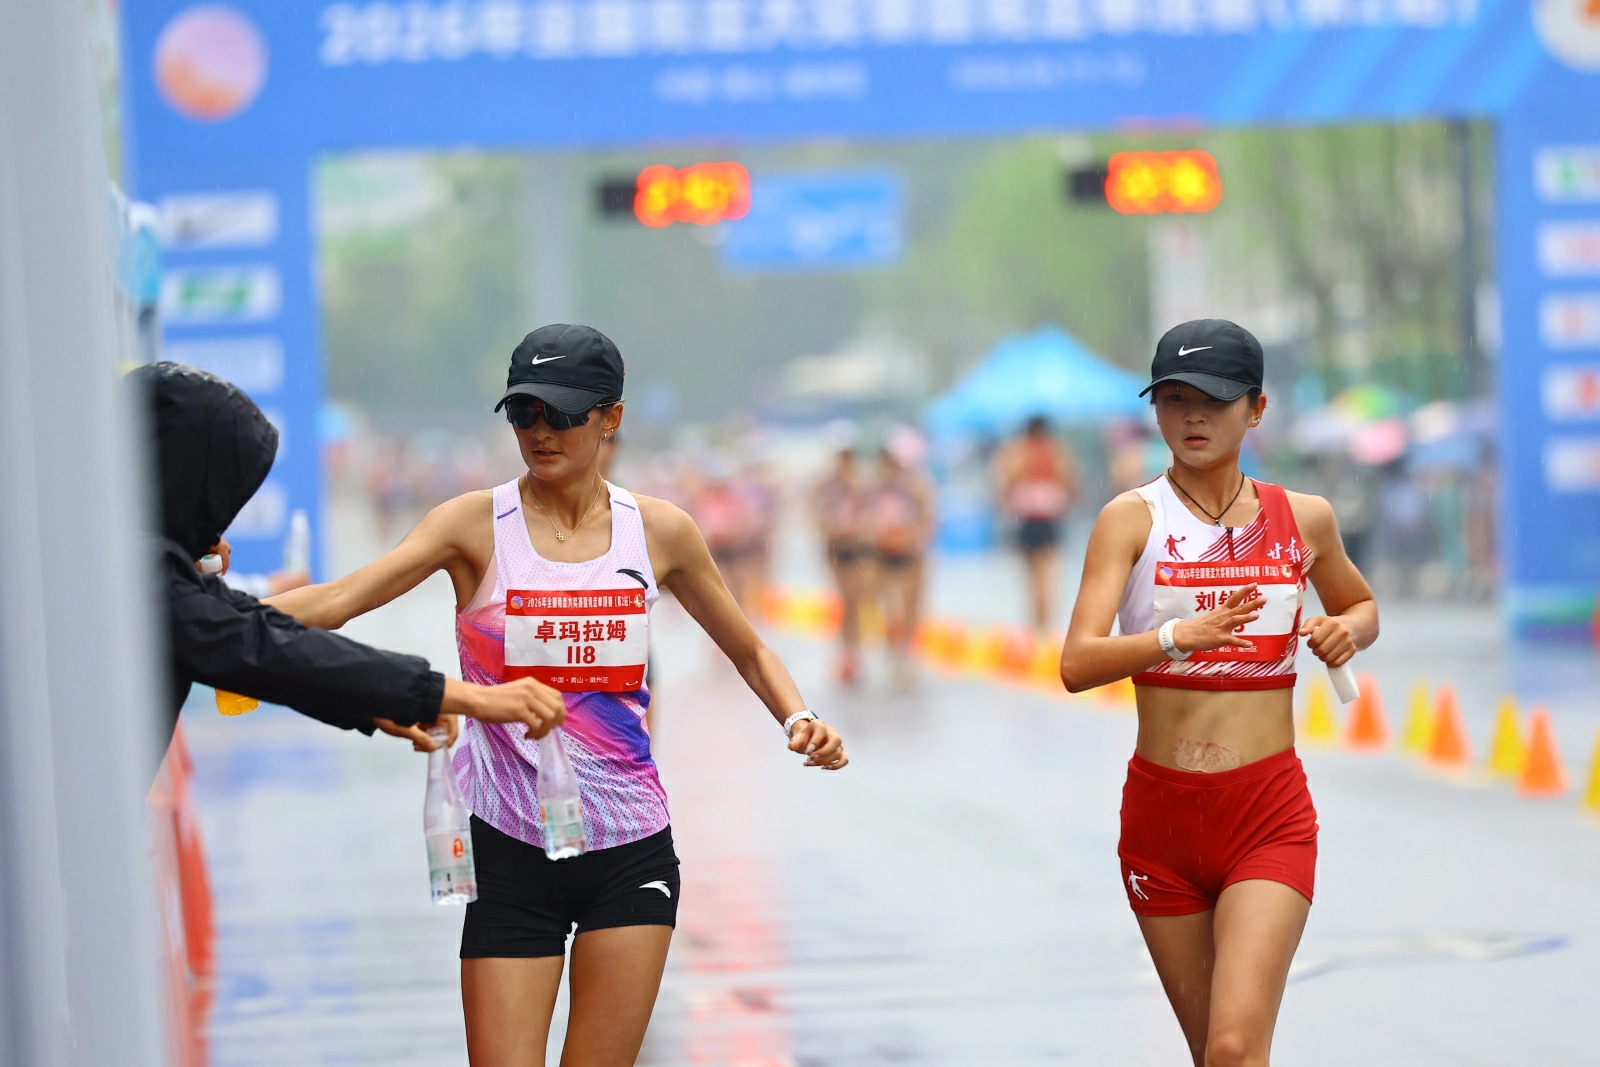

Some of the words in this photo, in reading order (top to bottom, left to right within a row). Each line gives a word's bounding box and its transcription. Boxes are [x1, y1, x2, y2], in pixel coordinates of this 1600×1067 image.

[534, 619, 627, 643] 卓玛拉姆
[567, 646, 596, 664] 118
